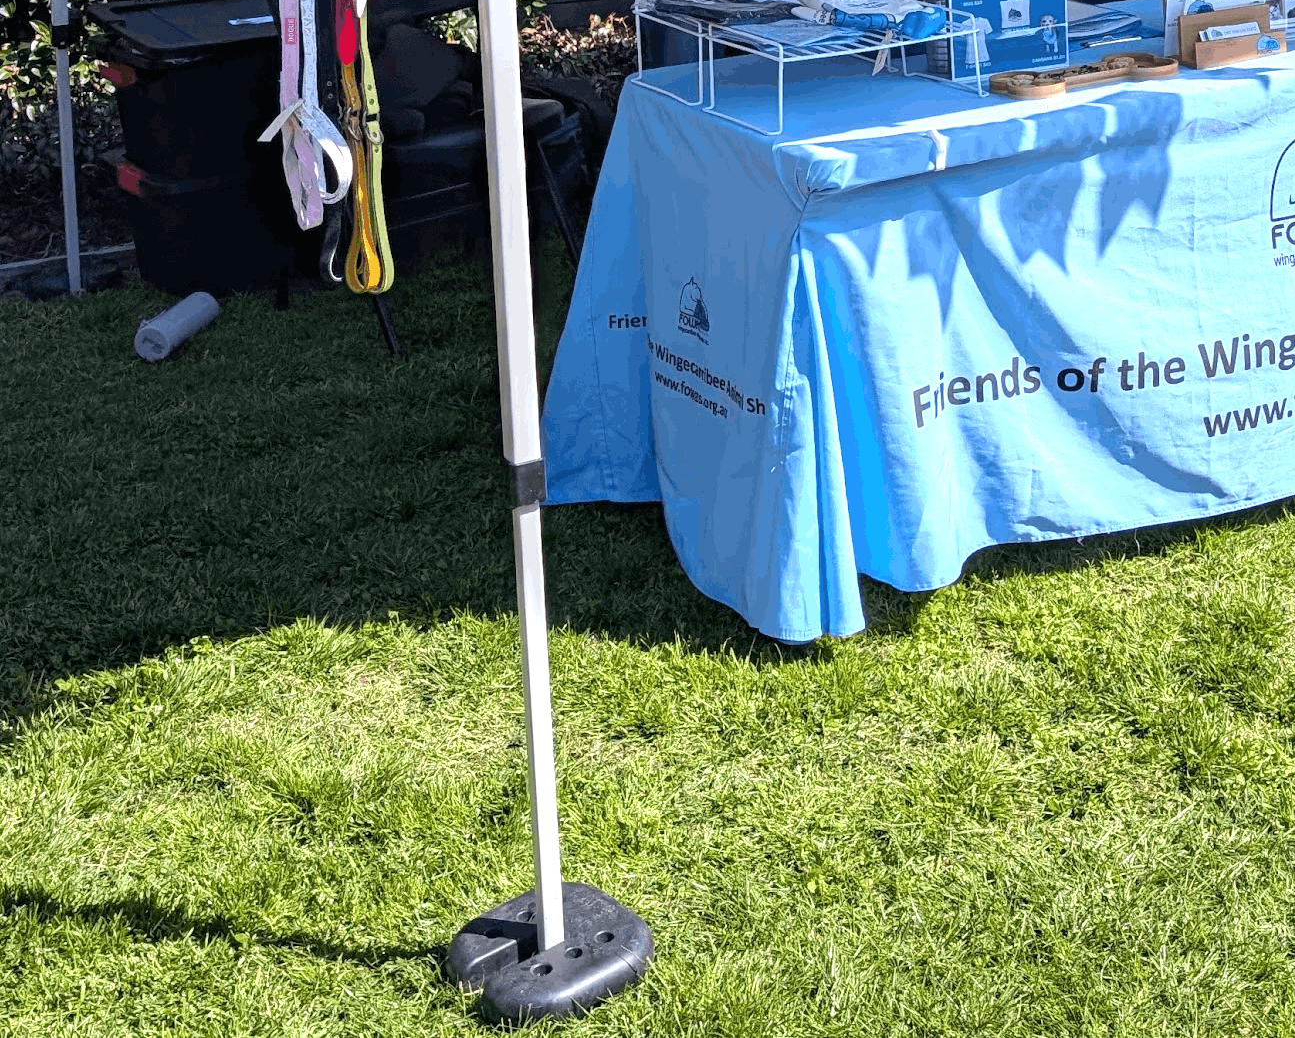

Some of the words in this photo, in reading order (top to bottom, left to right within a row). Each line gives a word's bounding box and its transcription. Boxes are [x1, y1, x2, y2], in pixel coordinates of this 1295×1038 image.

[655, 342, 726, 392] Wingecarribee
[913, 357, 1041, 428] Friends
[1056, 357, 1107, 393] of
[1117, 351, 1186, 392] the
